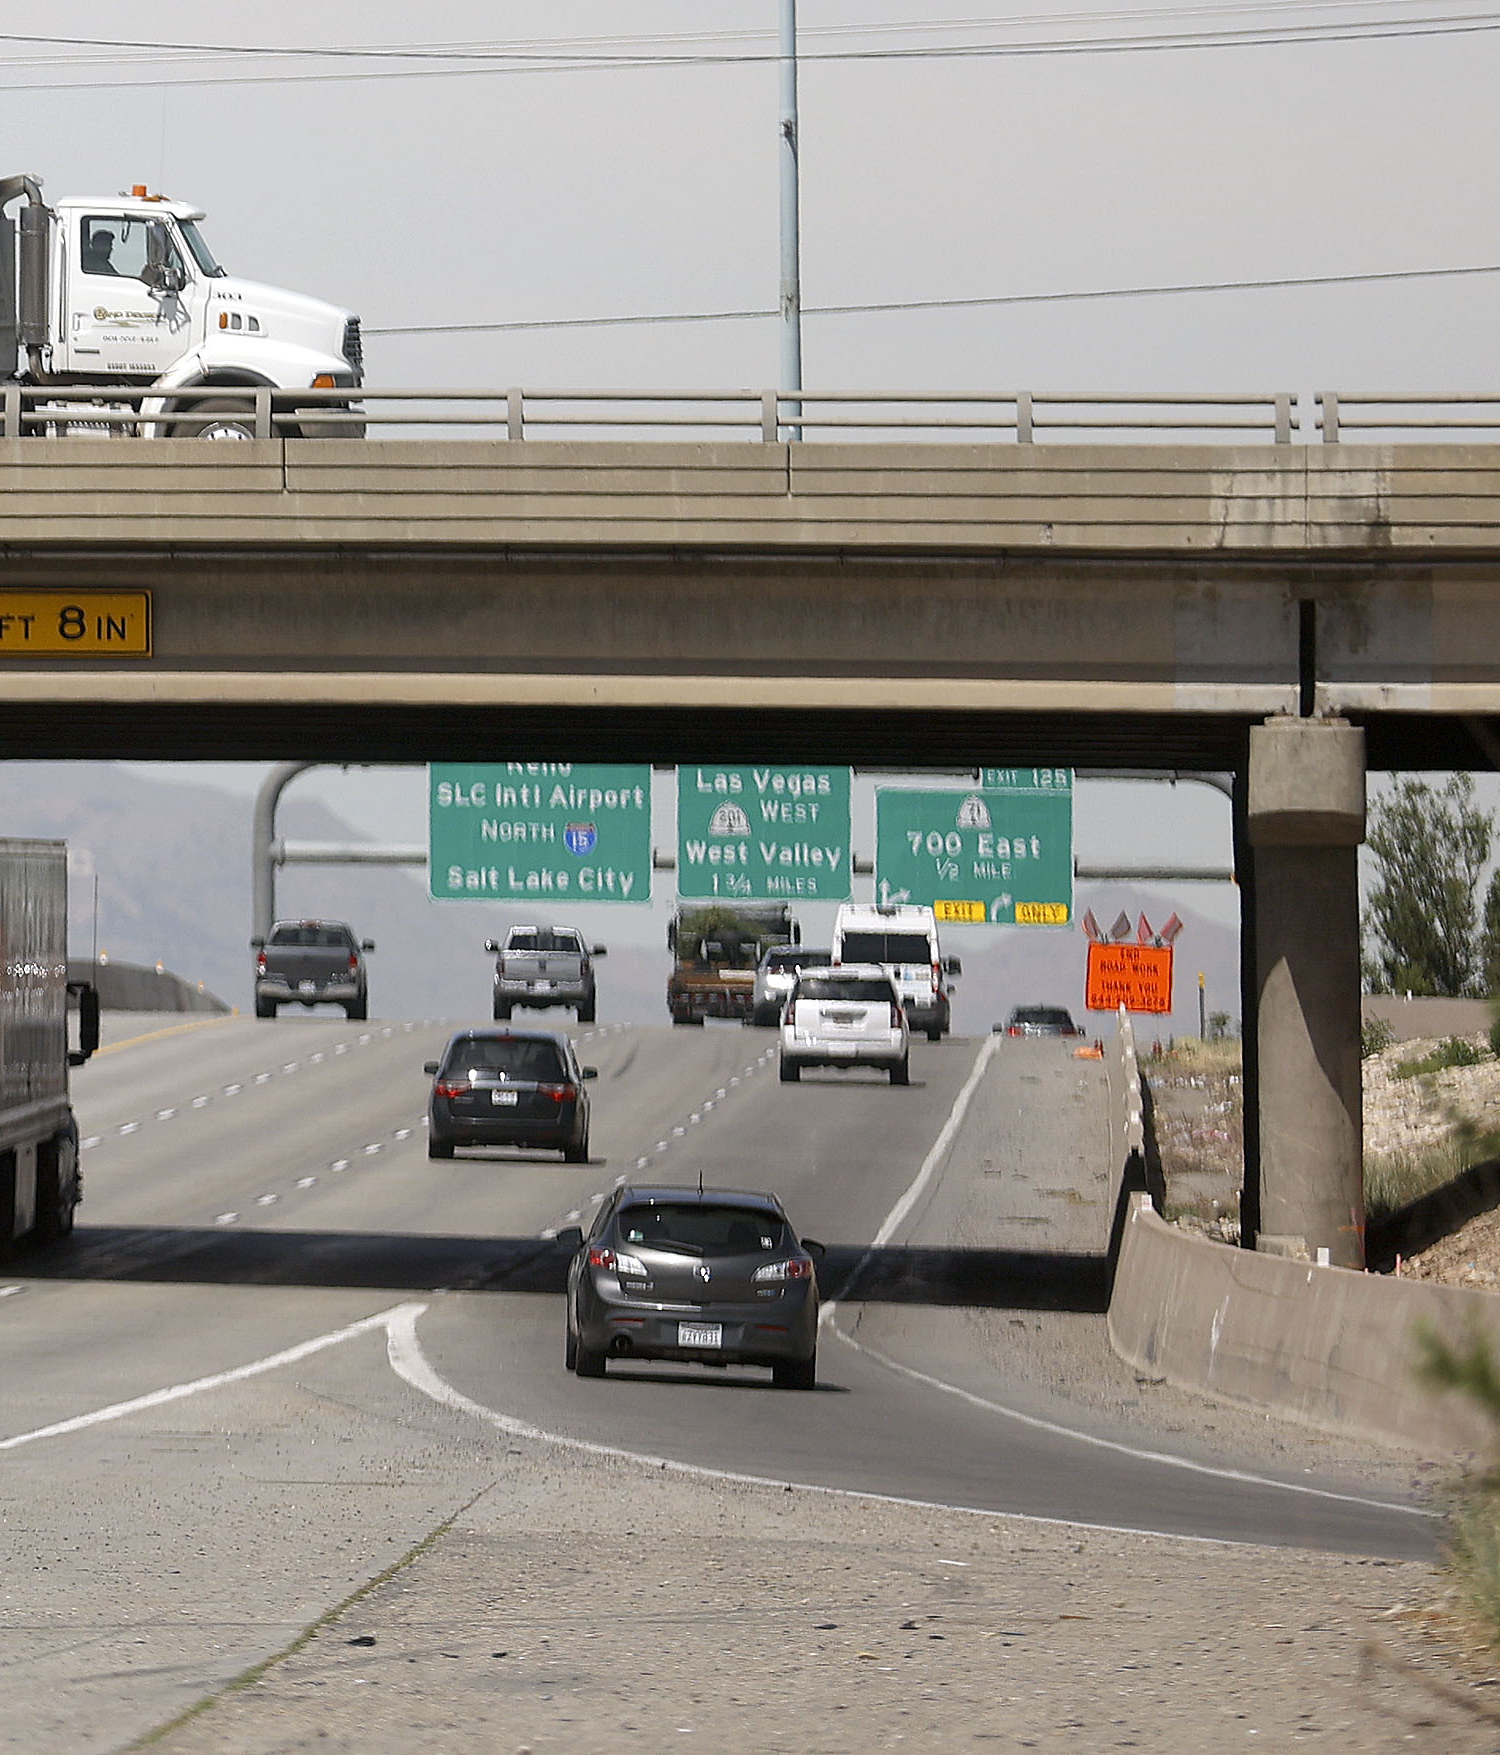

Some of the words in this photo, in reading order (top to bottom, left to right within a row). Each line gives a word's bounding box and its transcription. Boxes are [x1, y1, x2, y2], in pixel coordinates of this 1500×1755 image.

[59, 605, 86, 640] 8
[97, 615, 126, 640] IN
[697, 768, 743, 794] Las
[752, 768, 831, 800] Vegas
[988, 769, 1017, 785] EXIT
[1033, 767, 1067, 788] 125
[437, 781, 486, 807] SLC
[495, 782, 541, 808] Intl
[549, 783, 645, 813] Airport
[760, 799, 819, 823] WEST
[481, 818, 555, 843] NORTH
[573, 831, 588, 850] 15
[686, 840, 748, 866] West
[759, 842, 842, 872] Valley
[907, 831, 962, 857] 700
[978, 833, 1042, 859] East
[448, 865, 500, 891] Salt
[508, 866, 570, 892] Lake
[578, 866, 634, 897] City
[973, 861, 1013, 880] MILE
[766, 876, 818, 895] MILES
[943, 902, 974, 921] EXIT
[1021, 904, 1061, 922] ONLY
[1120, 947, 1140, 961] END
[1100, 960, 1125, 974] ROAD
[1131, 963, 1159, 977] WORK
[1101, 980, 1131, 993] THANK
[1138, 982, 1158, 994] YOU
